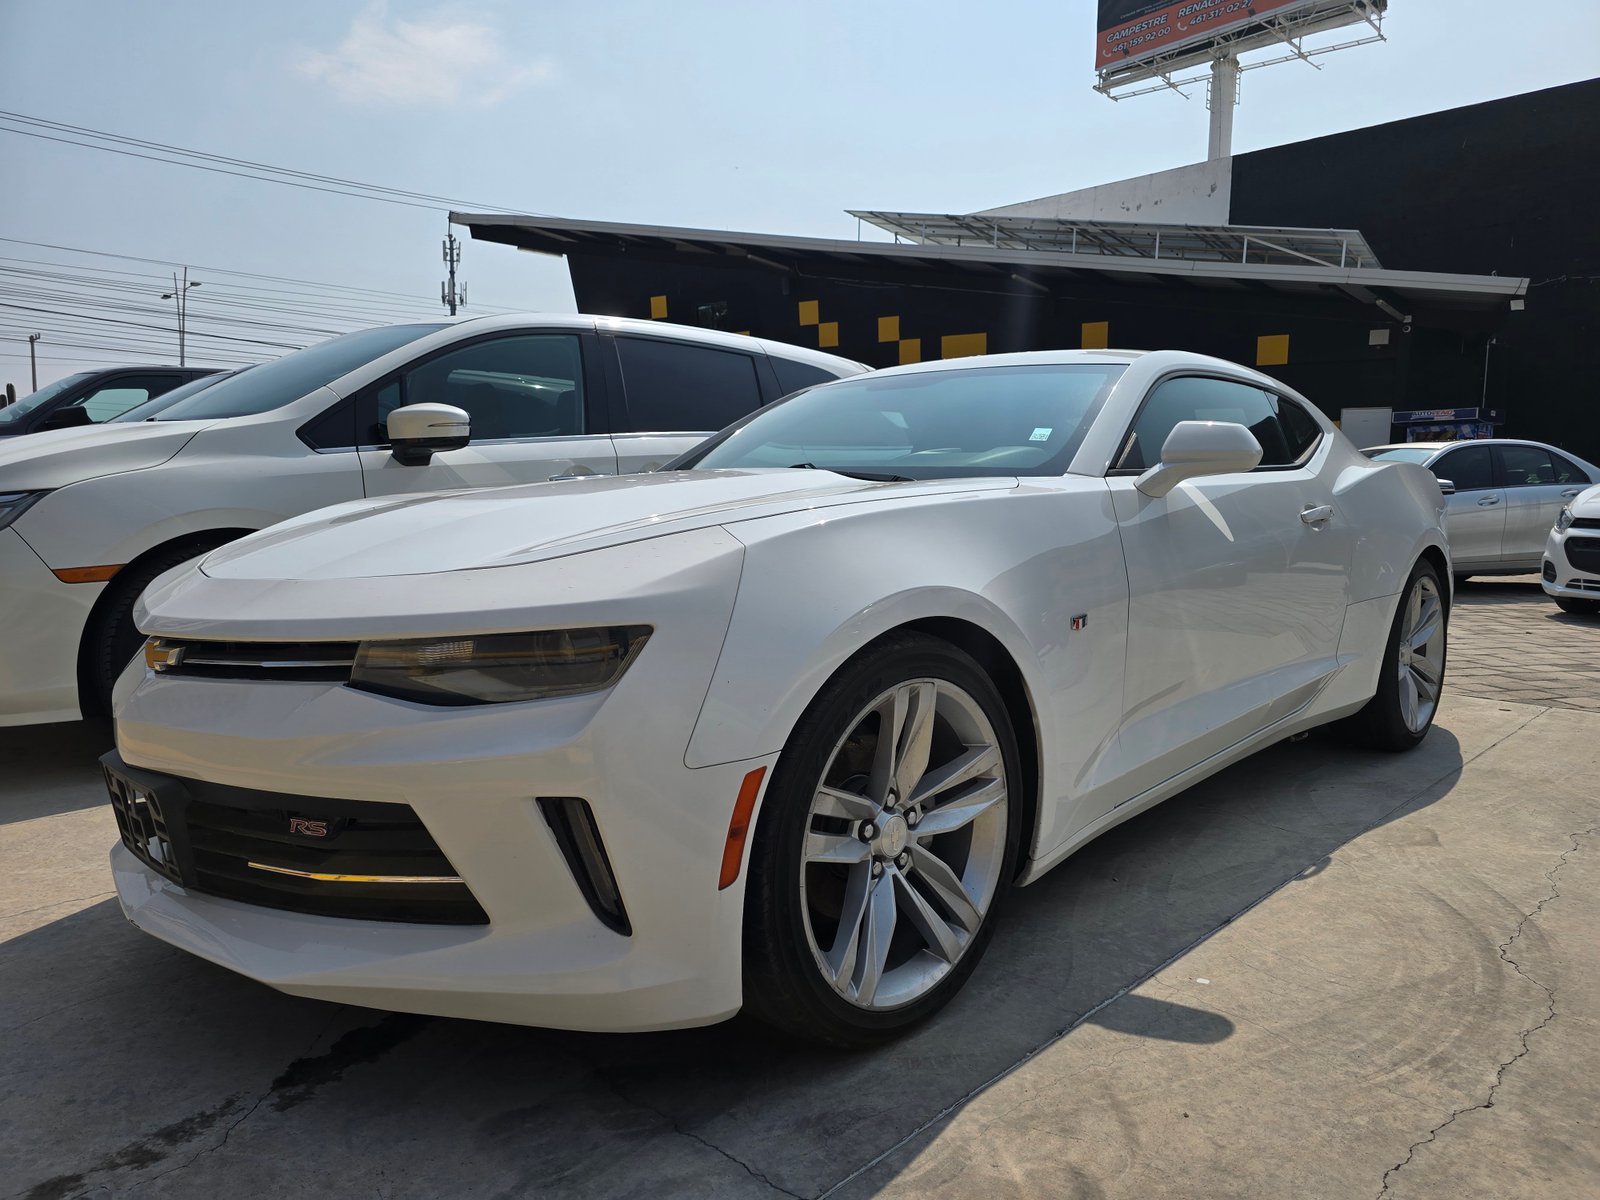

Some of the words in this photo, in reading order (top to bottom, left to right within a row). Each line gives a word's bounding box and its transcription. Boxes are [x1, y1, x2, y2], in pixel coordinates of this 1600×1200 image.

[1190, 13, 1206, 25] 461
[1208, 8, 1224, 19] 317
[1226, 2, 1240, 12] 02
[1241, 0, 1253, 9] 27
[1107, 14, 1168, 43] CAMPESTRE
[1112, 43, 1127, 52] 461
[1129, 36, 1144, 47] 159
[1146, 32, 1156, 41] 92
[1158, 27, 1170, 37] 00
[290, 818, 327, 837] RS
